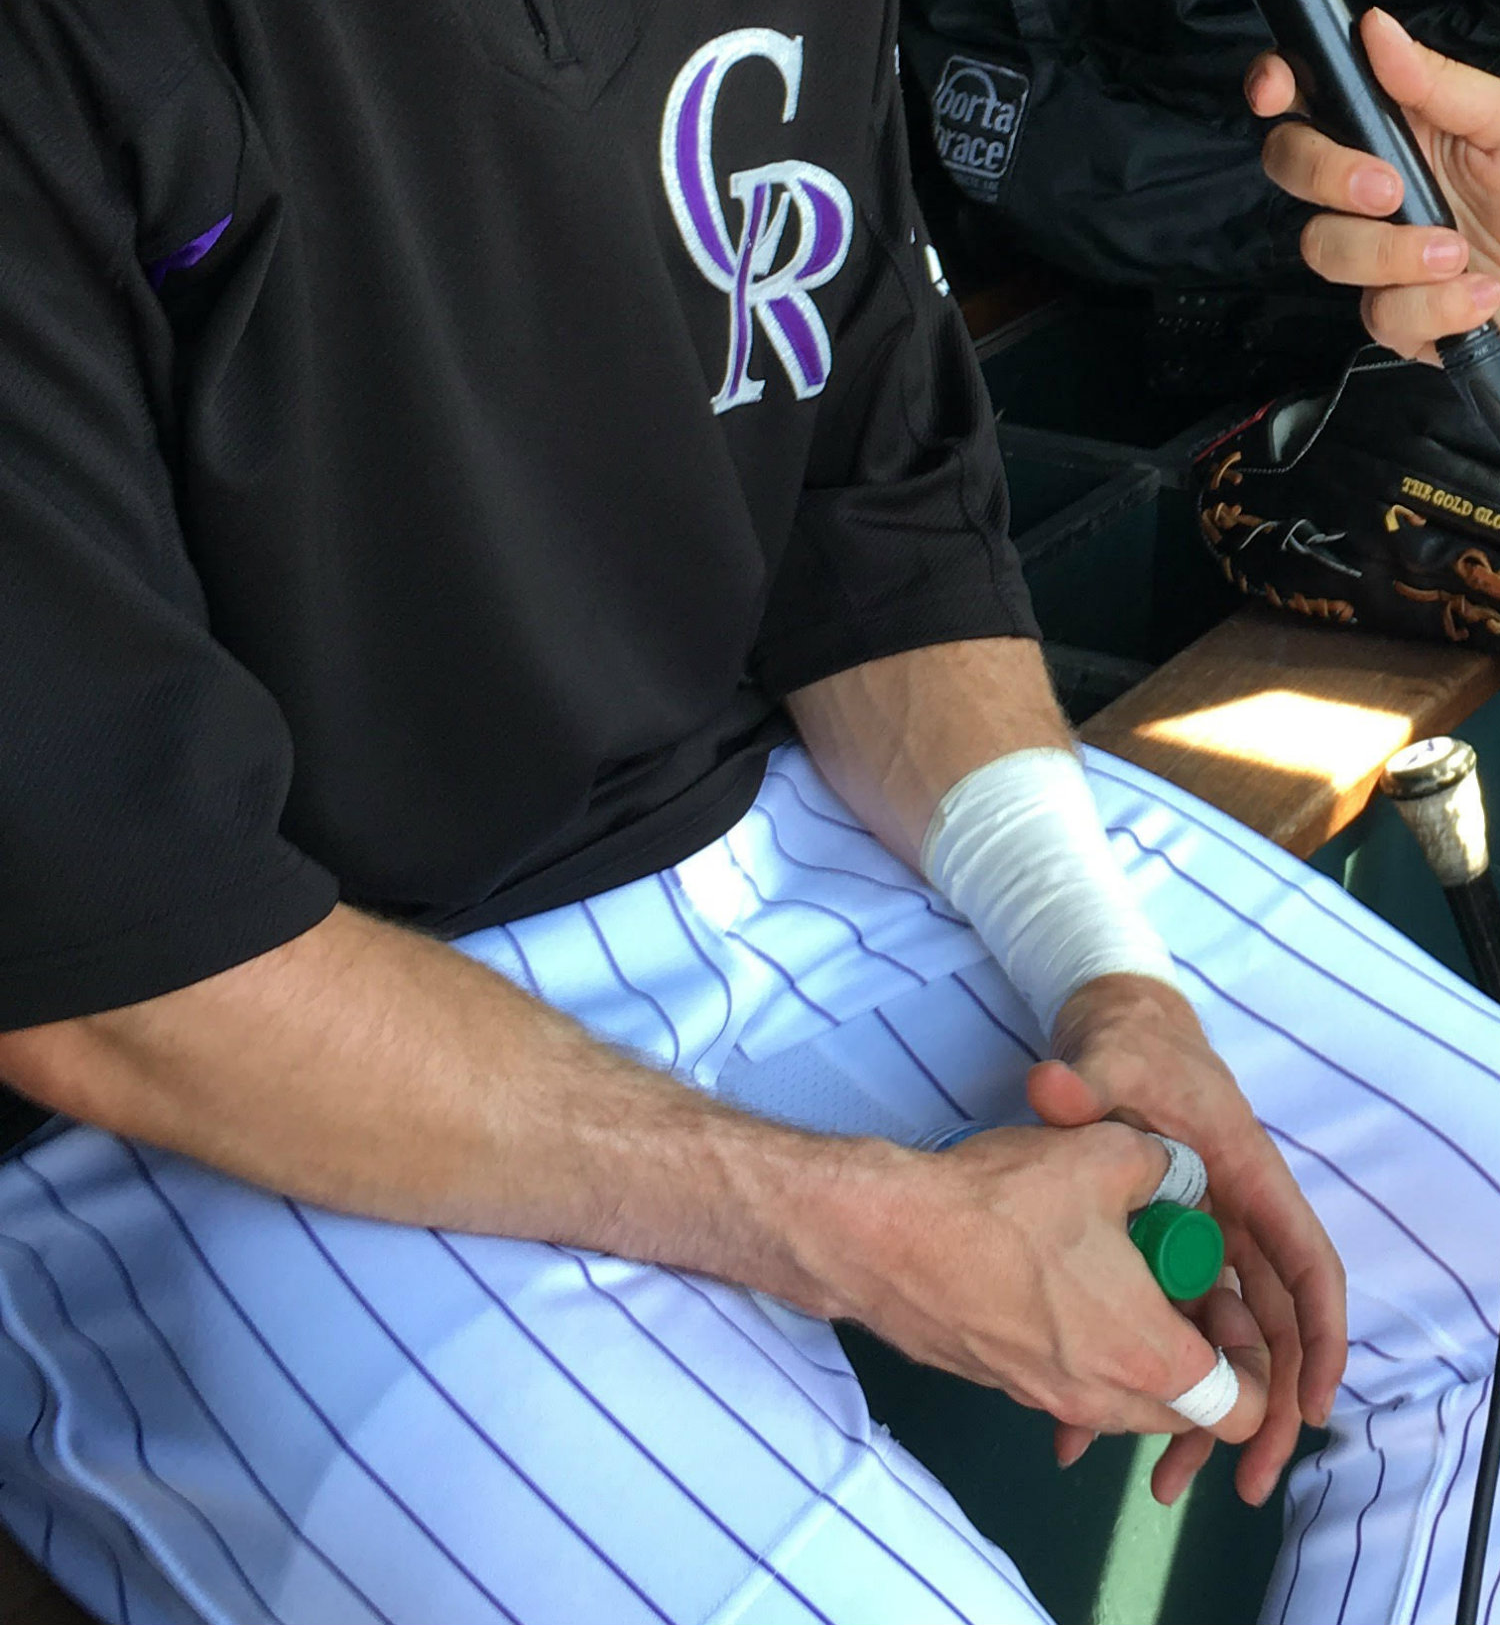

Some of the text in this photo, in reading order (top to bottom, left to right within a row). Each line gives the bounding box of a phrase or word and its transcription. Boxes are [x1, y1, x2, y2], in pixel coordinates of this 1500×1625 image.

[660, 27, 854, 415] CR
[1402, 477, 1433, 502] THE
[1431, 489, 1474, 517] GOLD
